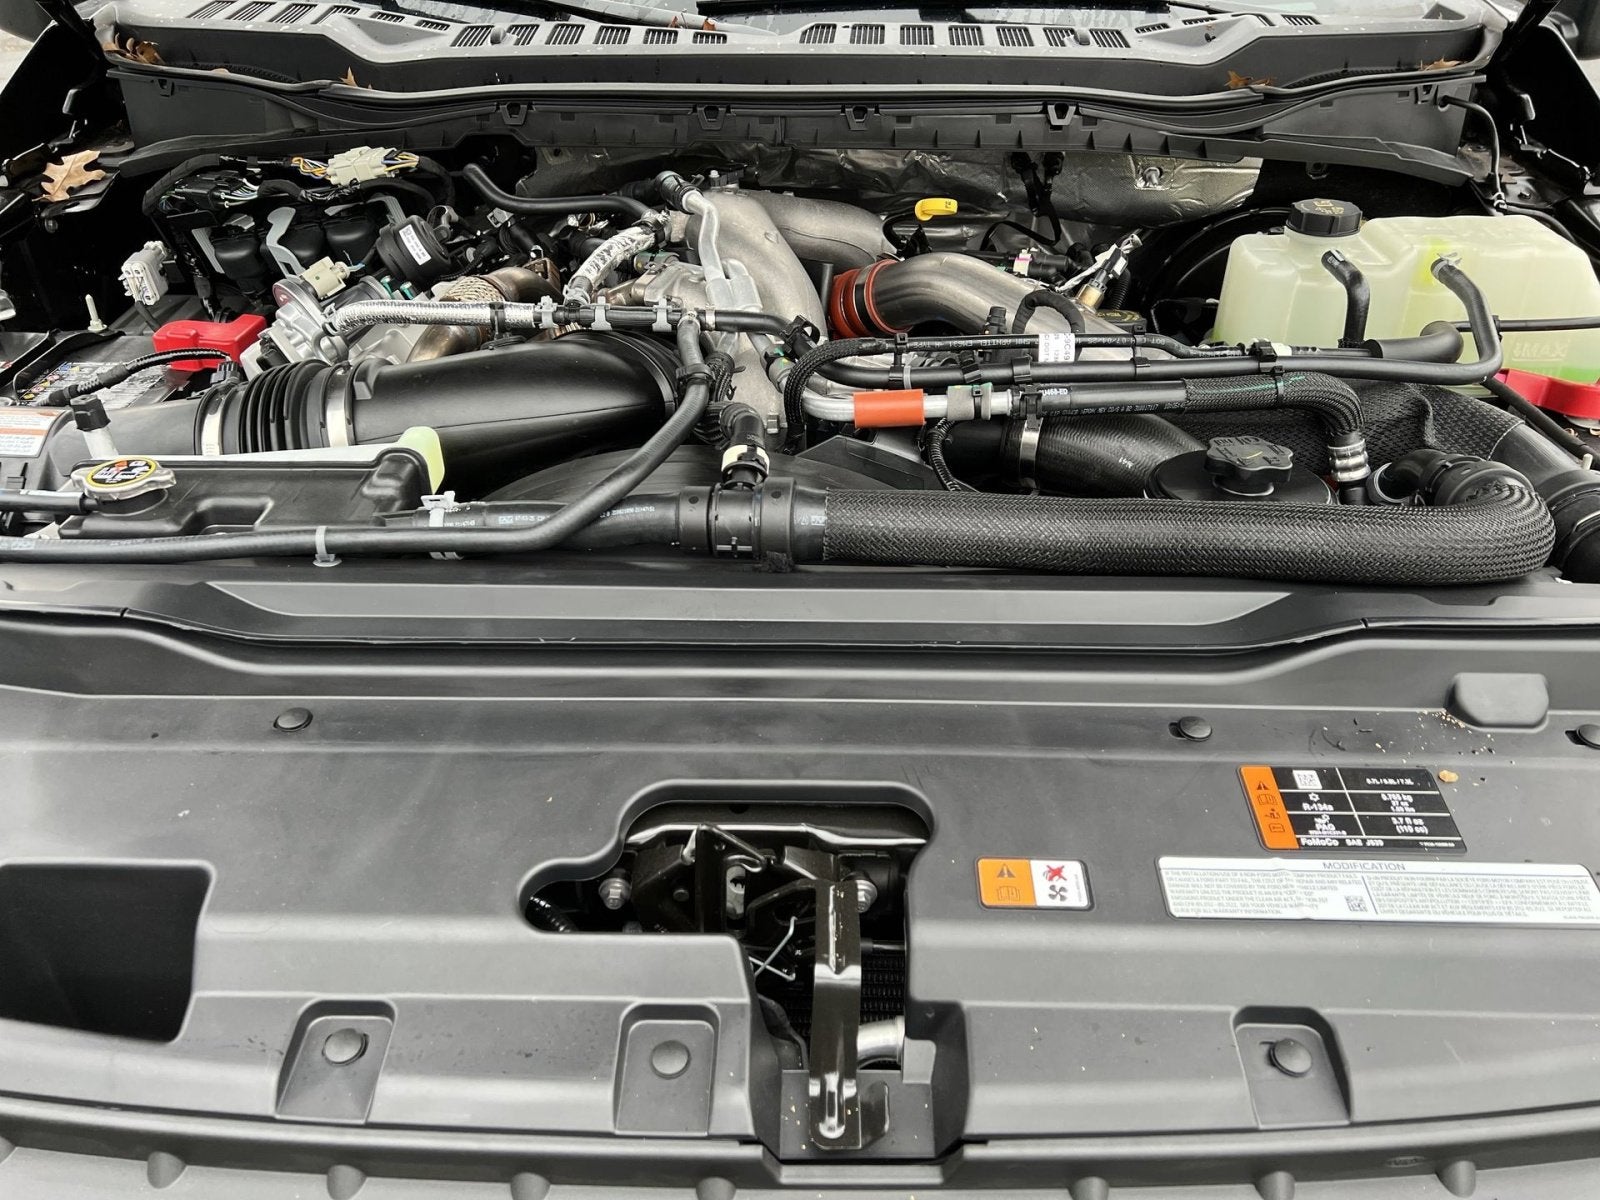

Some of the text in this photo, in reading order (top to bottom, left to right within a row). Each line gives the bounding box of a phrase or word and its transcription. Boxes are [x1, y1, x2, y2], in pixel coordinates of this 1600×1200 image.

[1302, 802, 1334, 811] R-134a
[1300, 837, 1339, 846] FoMoCo
[1322, 862, 1406, 871] MODIFICATION
